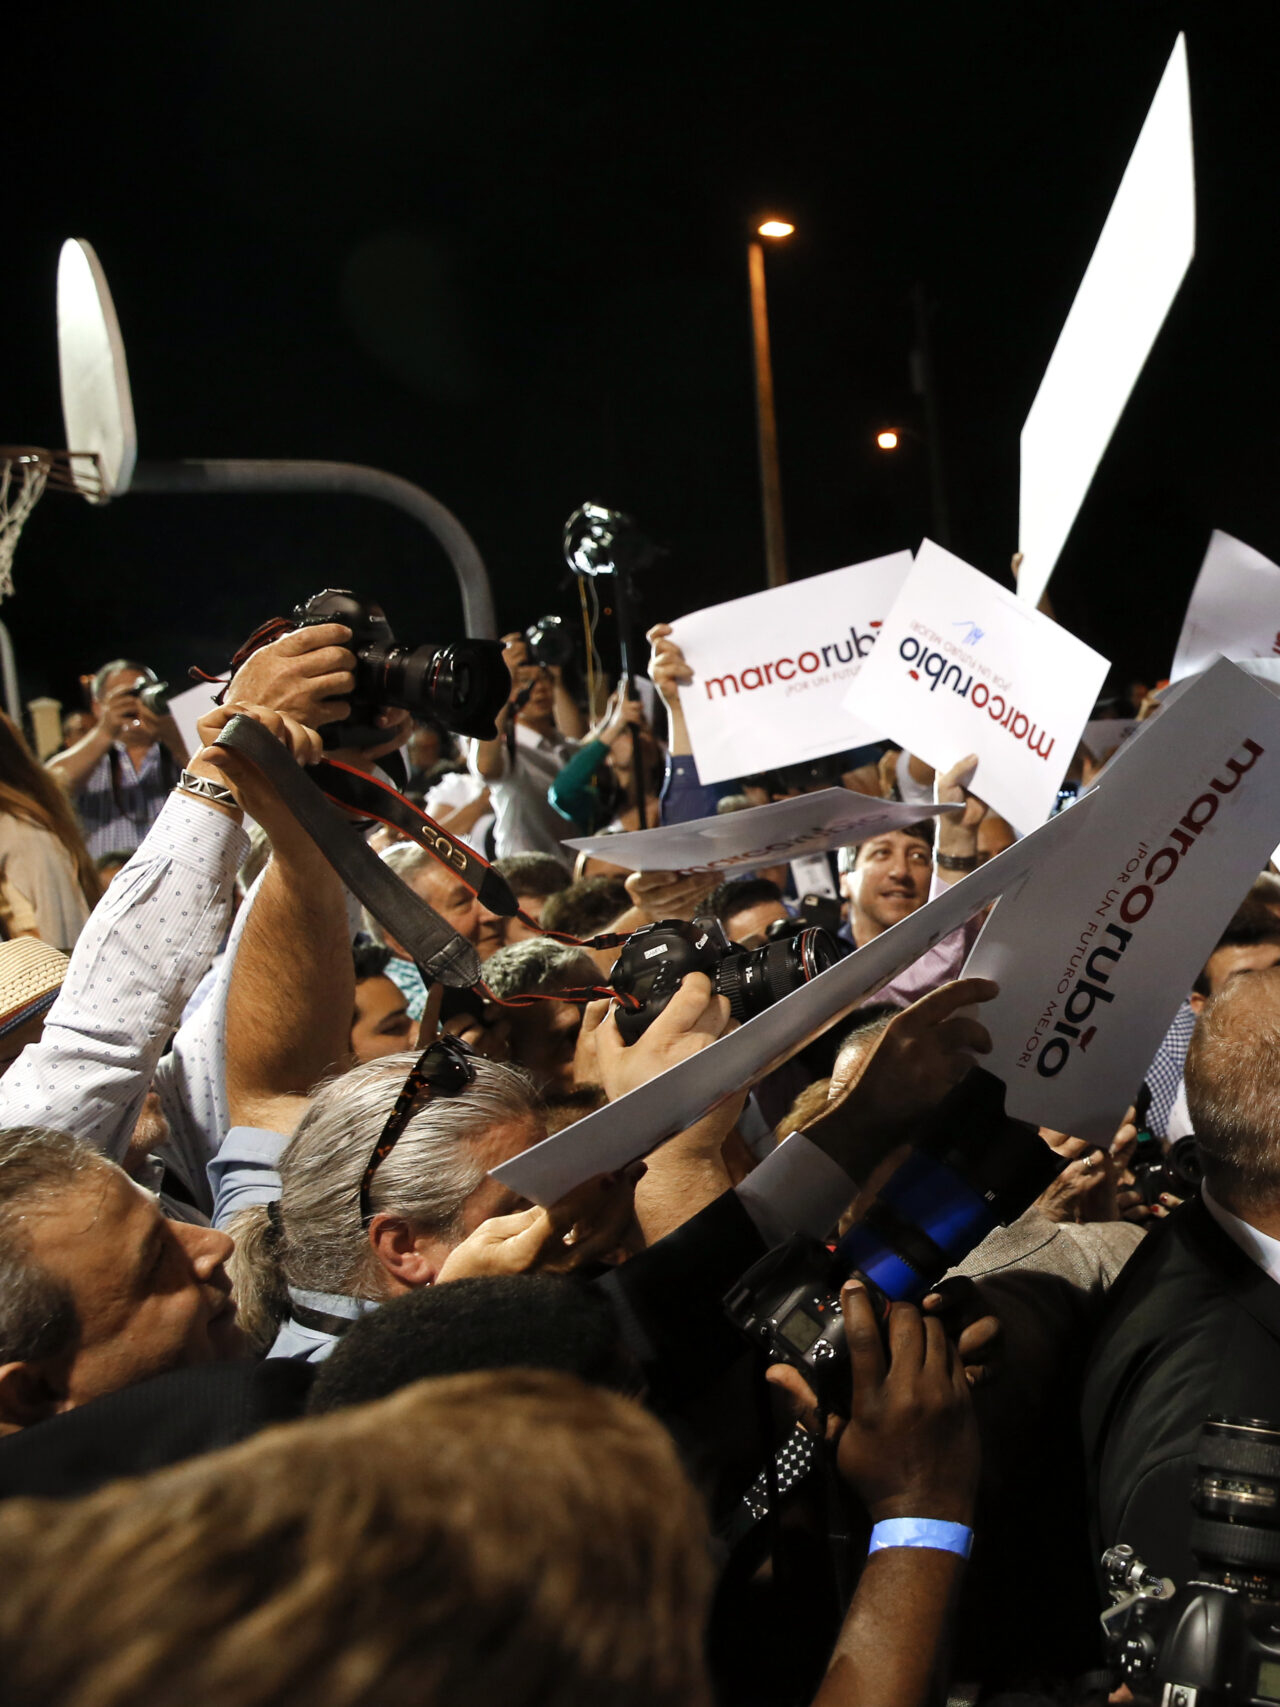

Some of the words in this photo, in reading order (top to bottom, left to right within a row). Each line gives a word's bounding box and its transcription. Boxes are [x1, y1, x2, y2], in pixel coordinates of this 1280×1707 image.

[899, 637, 1055, 761] marcorubio
[422, 826, 467, 871] EOS
[1036, 738, 1265, 1078] marcorubio
[1093, 887, 1120, 919] UN
[1056, 921, 1099, 995] FUTURO
[1016, 1000, 1059, 1069] MEJOR!
